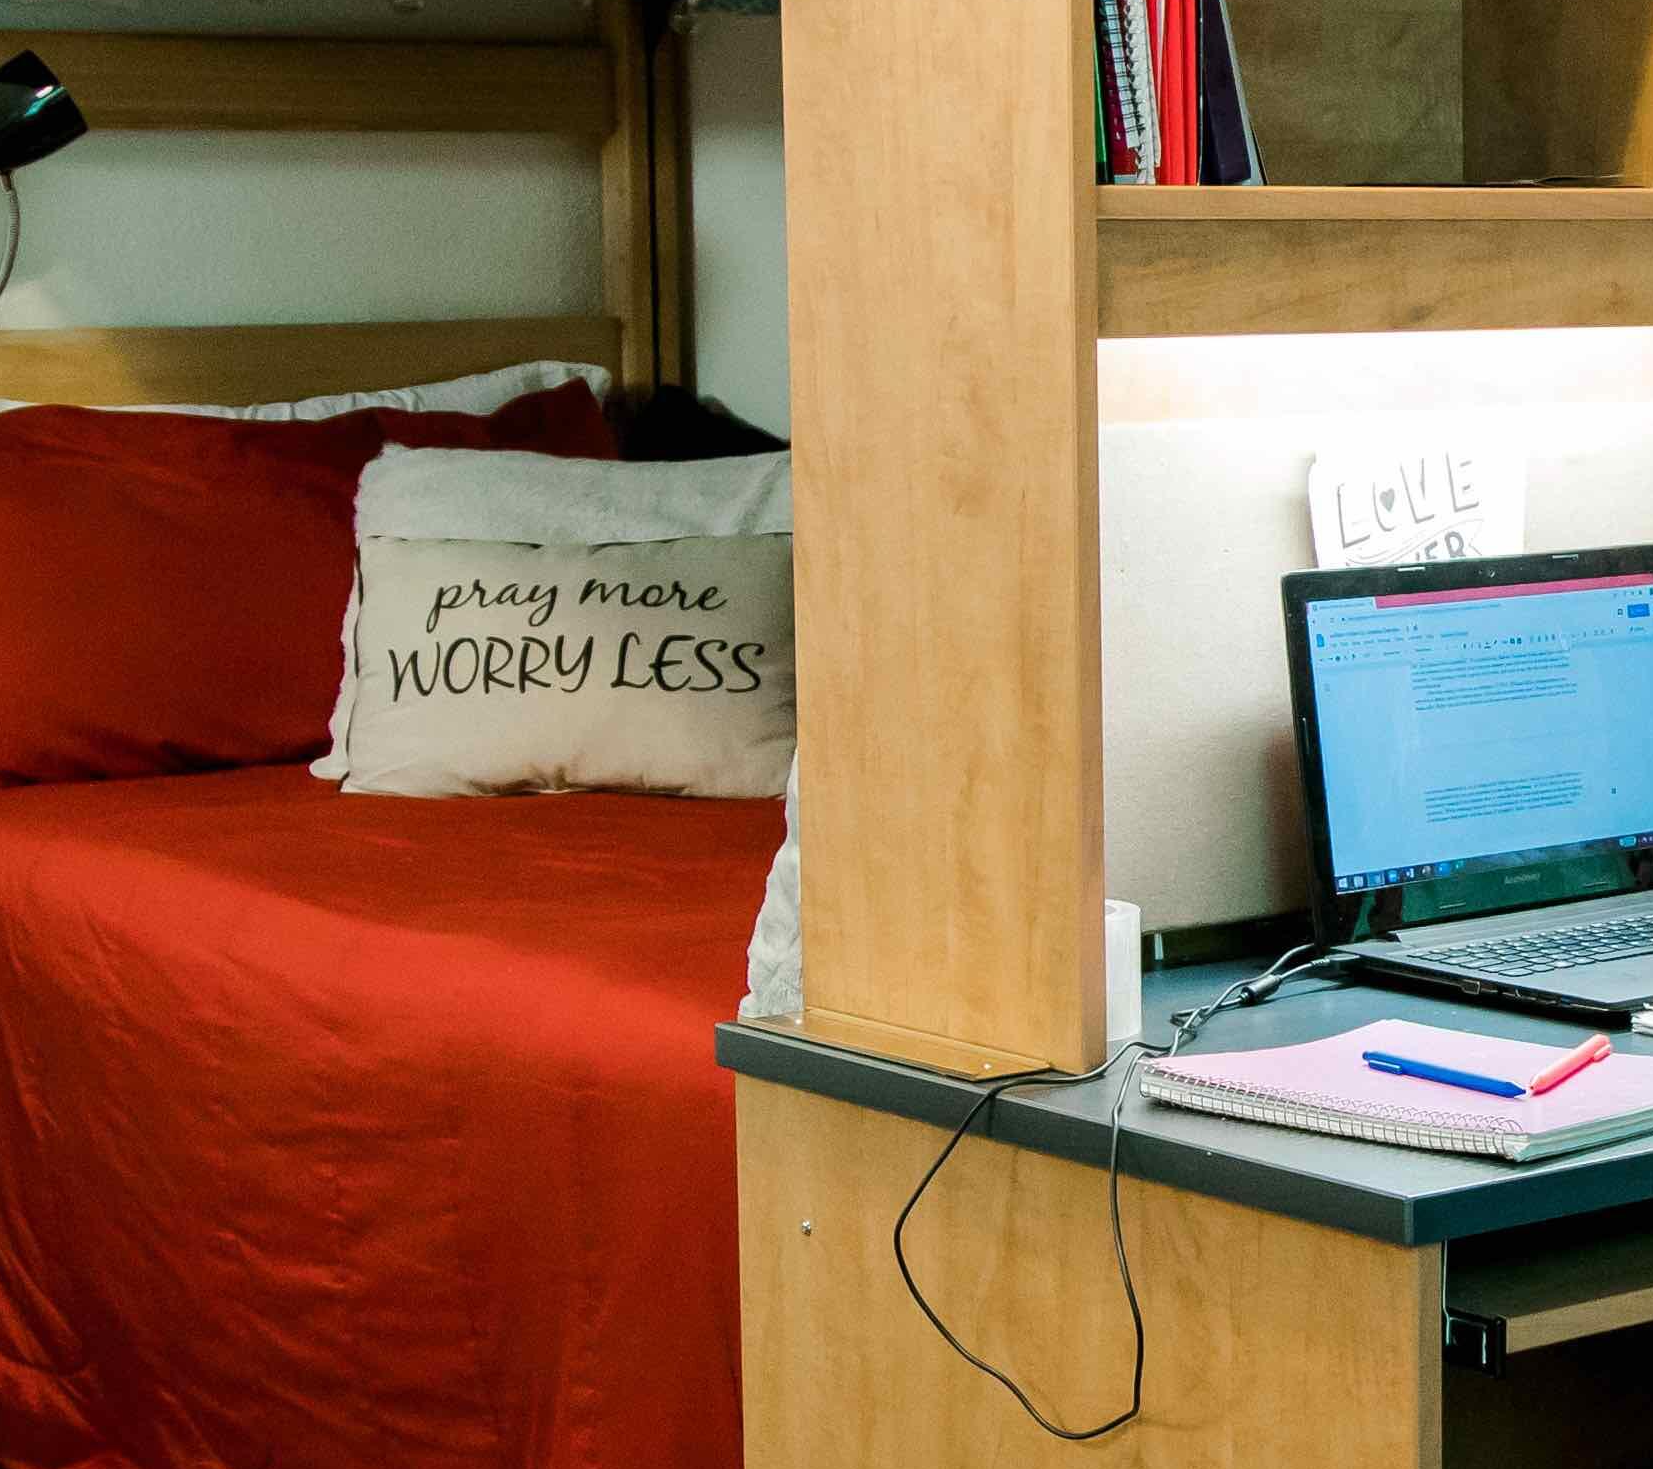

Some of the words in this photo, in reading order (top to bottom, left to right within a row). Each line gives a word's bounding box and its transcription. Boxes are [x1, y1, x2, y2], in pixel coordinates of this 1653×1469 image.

[425, 577, 560, 633] pray
[578, 577, 729, 612] more
[387, 633, 595, 703] WORRY
[609, 631, 766, 693] LESS
